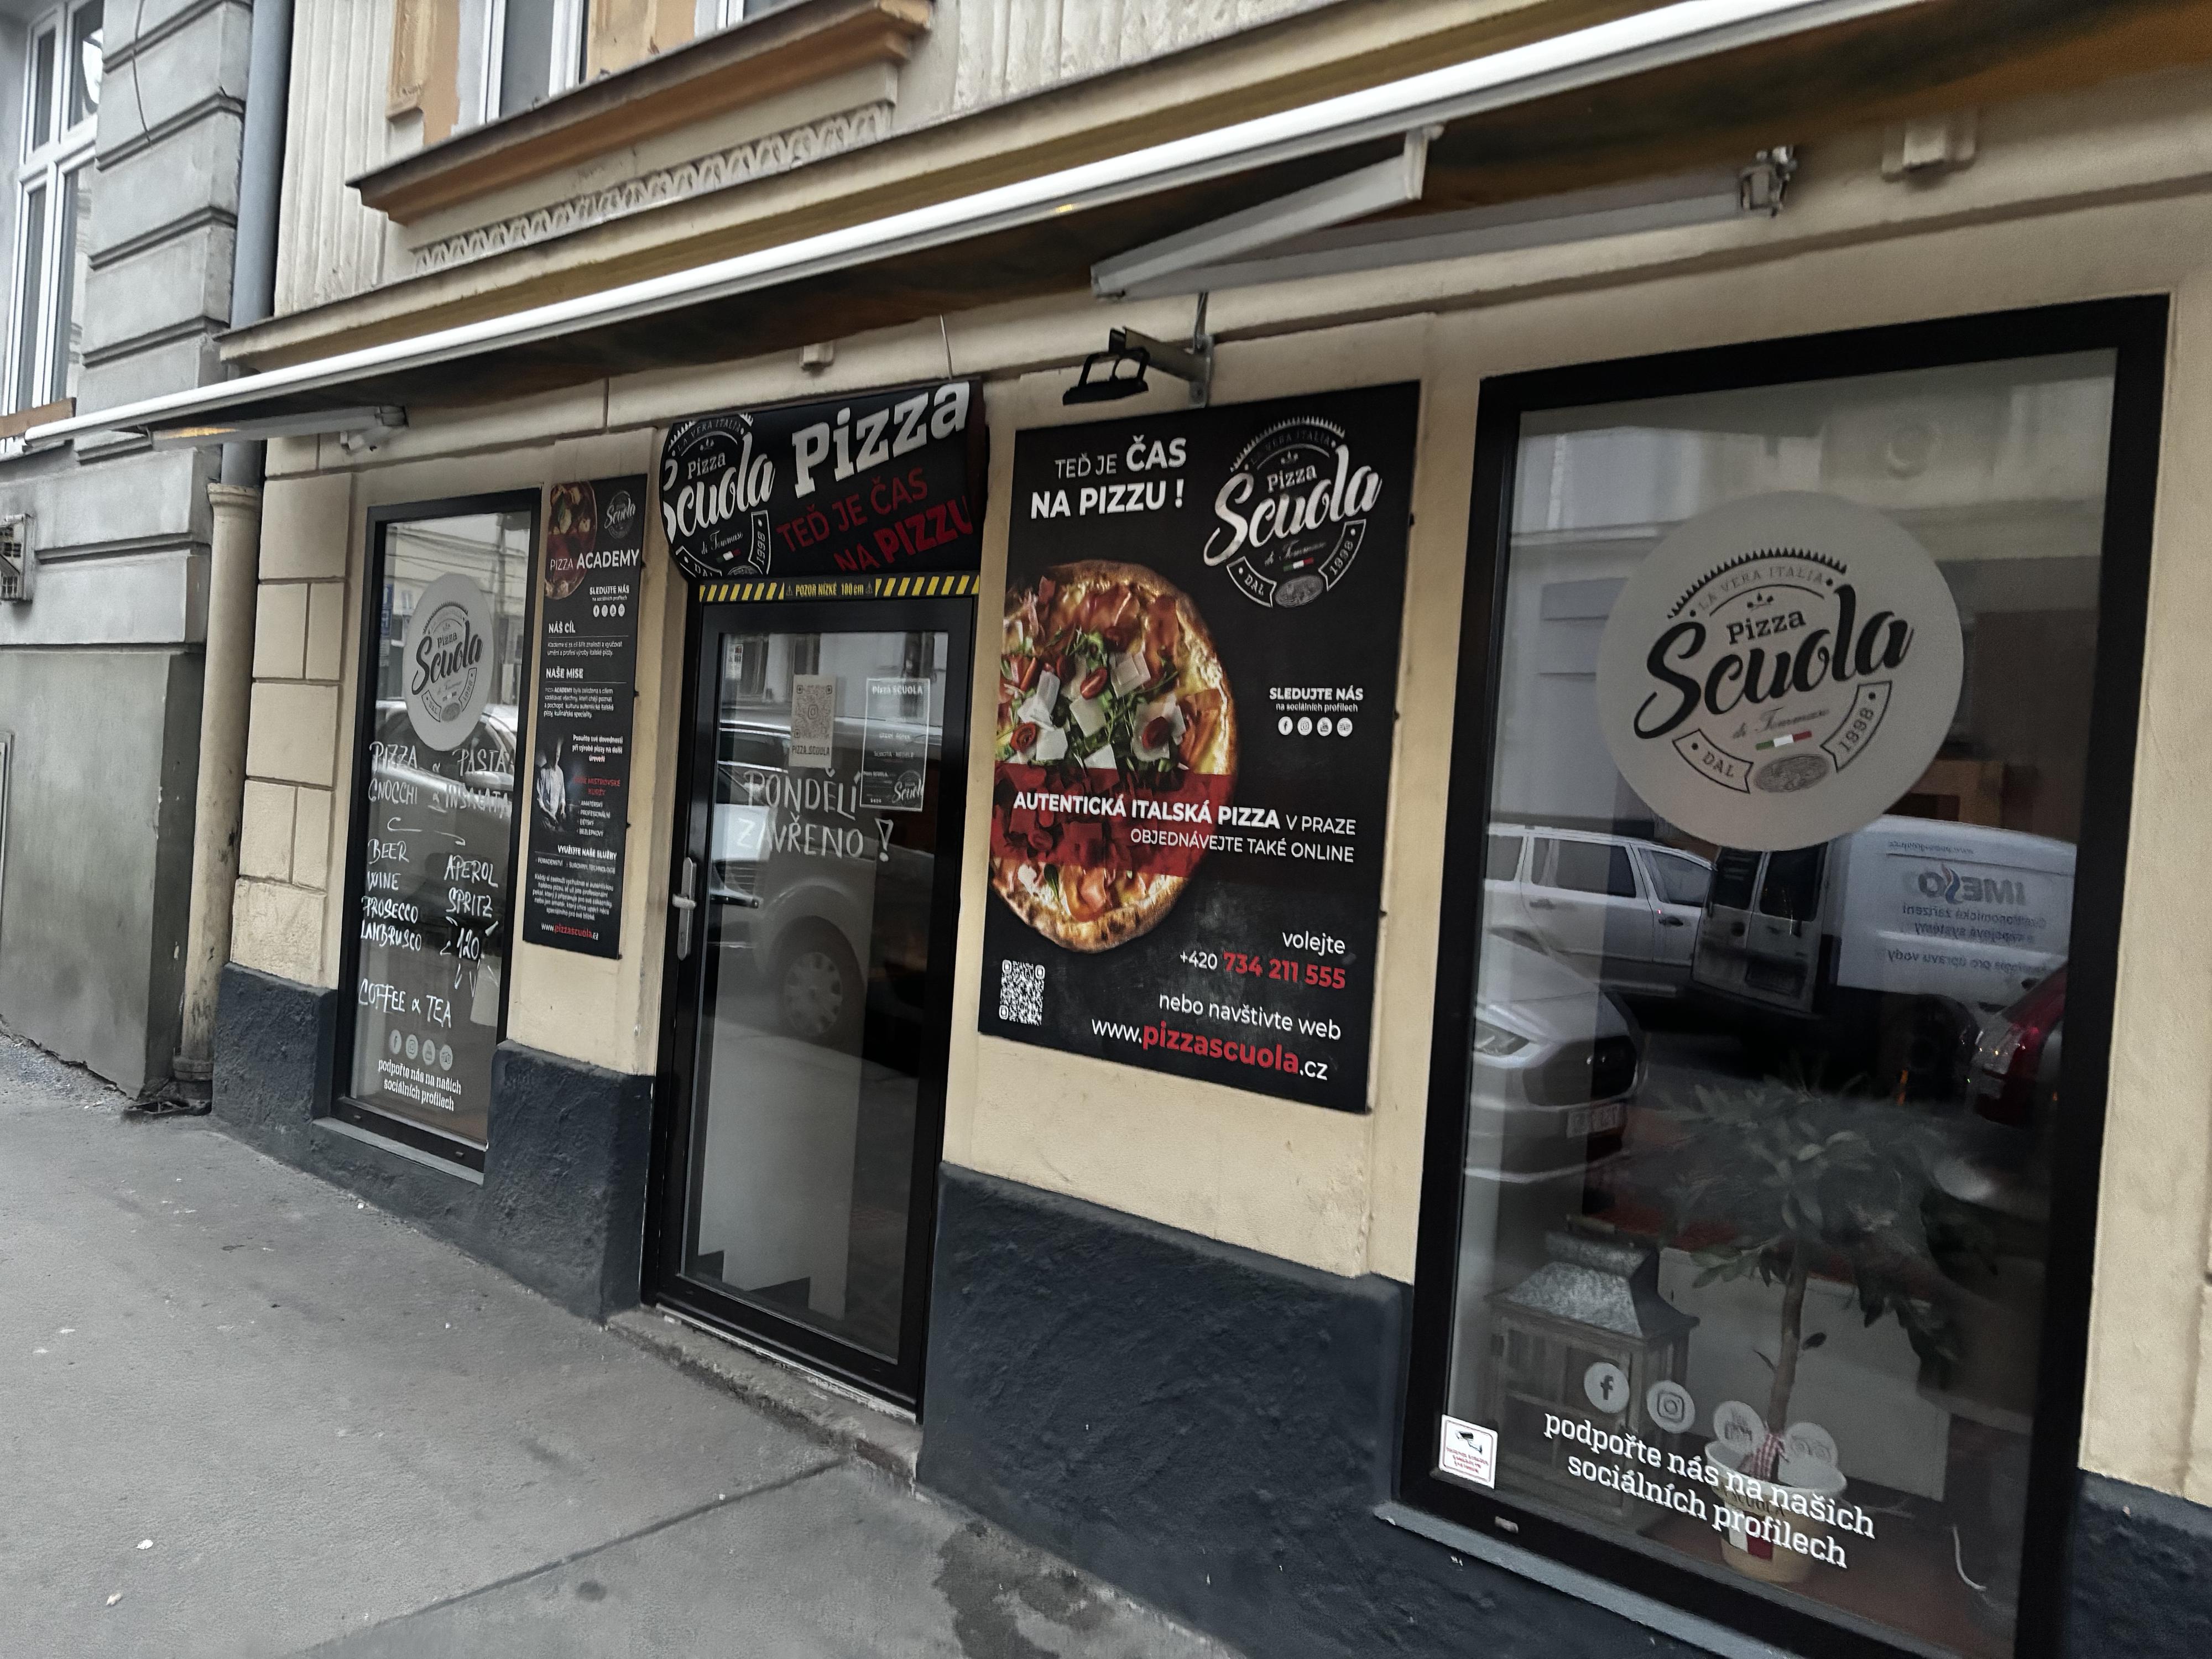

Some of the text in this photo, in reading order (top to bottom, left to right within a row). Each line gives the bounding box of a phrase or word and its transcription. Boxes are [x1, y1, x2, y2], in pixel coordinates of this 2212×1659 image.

[691, 420, 712, 438] VERA
[715, 418, 742, 432] ITALIA
[792, 381, 971, 498] Pizza
[687, 452, 726, 480] Pizza
[1055, 435, 1186, 478] TEĎ JE ČAS
[1267, 465, 1317, 493] Pizza
[777, 466, 928, 552] TEĎ JE ČAS
[1031, 478, 1184, 519] NA PIZZU !
[1203, 444, 1383, 566] Scuola
[756, 531, 765, 566] 1998
[833, 495, 974, 572] NA PIZZU
[550, 549, 639, 571] PIZZA ACADEMY
[589, 584, 629, 595] SLEDUJTE NÁS
[796, 584, 816, 597] POZOR
[841, 582, 852, 596] 180
[1244, 574, 1265, 596] DAL
[1699, 566, 1823, 610] LA VERA ITALIA
[437, 632, 458, 648] Pizza
[549, 620, 576, 634] NÁŠ CÍL
[1726, 609, 1806, 646] Pizza
[411, 620, 483, 695] Scuola
[546, 666, 583, 679] NAŠE MISE
[1634, 584, 1914, 739] Scuola
[893, 685, 923, 695] SCUOLA
[1270, 686, 1363, 701] SLEDUJTE NÁS
[1276, 701, 1358, 714] na sociálních profilech
[1840, 707, 1875, 752] 1998
[369, 741, 418, 773] PIZZA
[452, 748, 509, 776] PASTA
[1701, 751, 1735, 779] DAL
[744, 768, 860, 821] PONDĚLÍ
[1014, 791, 1356, 836] AUTENTICKÁ ITALSKÁ PIZZA V PRAZE
[368, 838, 409, 865] BEER
[737, 811, 864, 859] ZAVŘENO
[1130, 828, 1355, 863] OBJEDNÁVEJTE TAKÉ ONLINE
[367, 871, 401, 891] WINE
[444, 854, 498, 888] APEROL
[361, 895, 419, 924] PROSECCO
[446, 887, 493, 917] SPRITZ
[1282, 930, 1346, 956] volejte
[1180, 950, 1346, 990] +420 734 211 555
[359, 978, 406, 1014] COFFEE
[426, 995, 452, 1029] TEA
[1159, 994, 1341, 1041] nebo navštivte web
[1092, 1018, 1328, 1081] www.pizzascuola.cz
[426, 1074, 435, 1086] na
[1544, 1411, 1876, 1541] podpořte nás na našich
[1567, 1453, 1848, 1569] sociálních profilech
